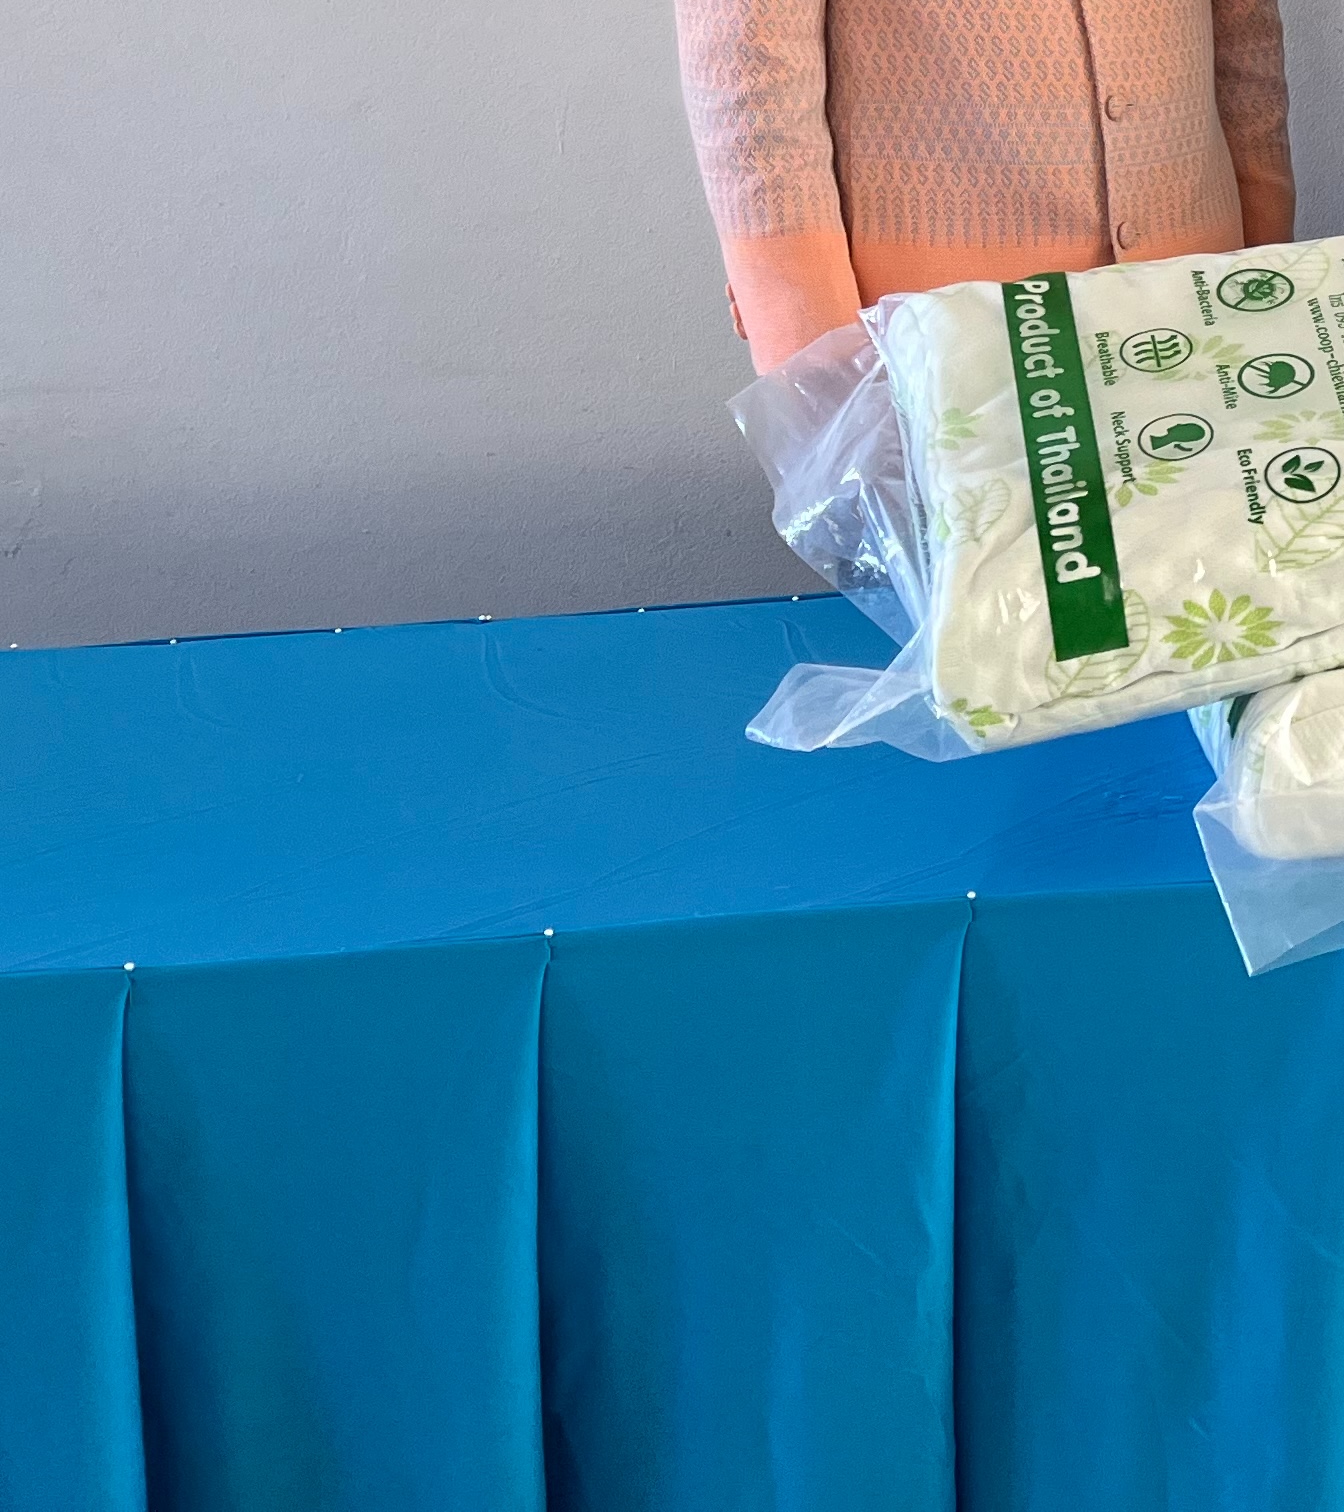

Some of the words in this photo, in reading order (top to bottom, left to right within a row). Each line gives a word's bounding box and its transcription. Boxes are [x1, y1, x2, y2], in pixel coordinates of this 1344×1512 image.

[1191, 270, 1216, 326] Anti-Bacteria
[1014, 279, 1065, 379] Product
[1096, 331, 1116, 387] Breathable
[1029, 388, 1075, 418] of
[1216, 364, 1237, 410] Anti-Mite
[1111, 410, 1127, 437] Neck
[1114, 439, 1137, 485] Support
[1237, 448, 1256, 467] Eco
[1036, 425, 1102, 584] Thailand
[1242, 468, 1268, 525] Friendly
